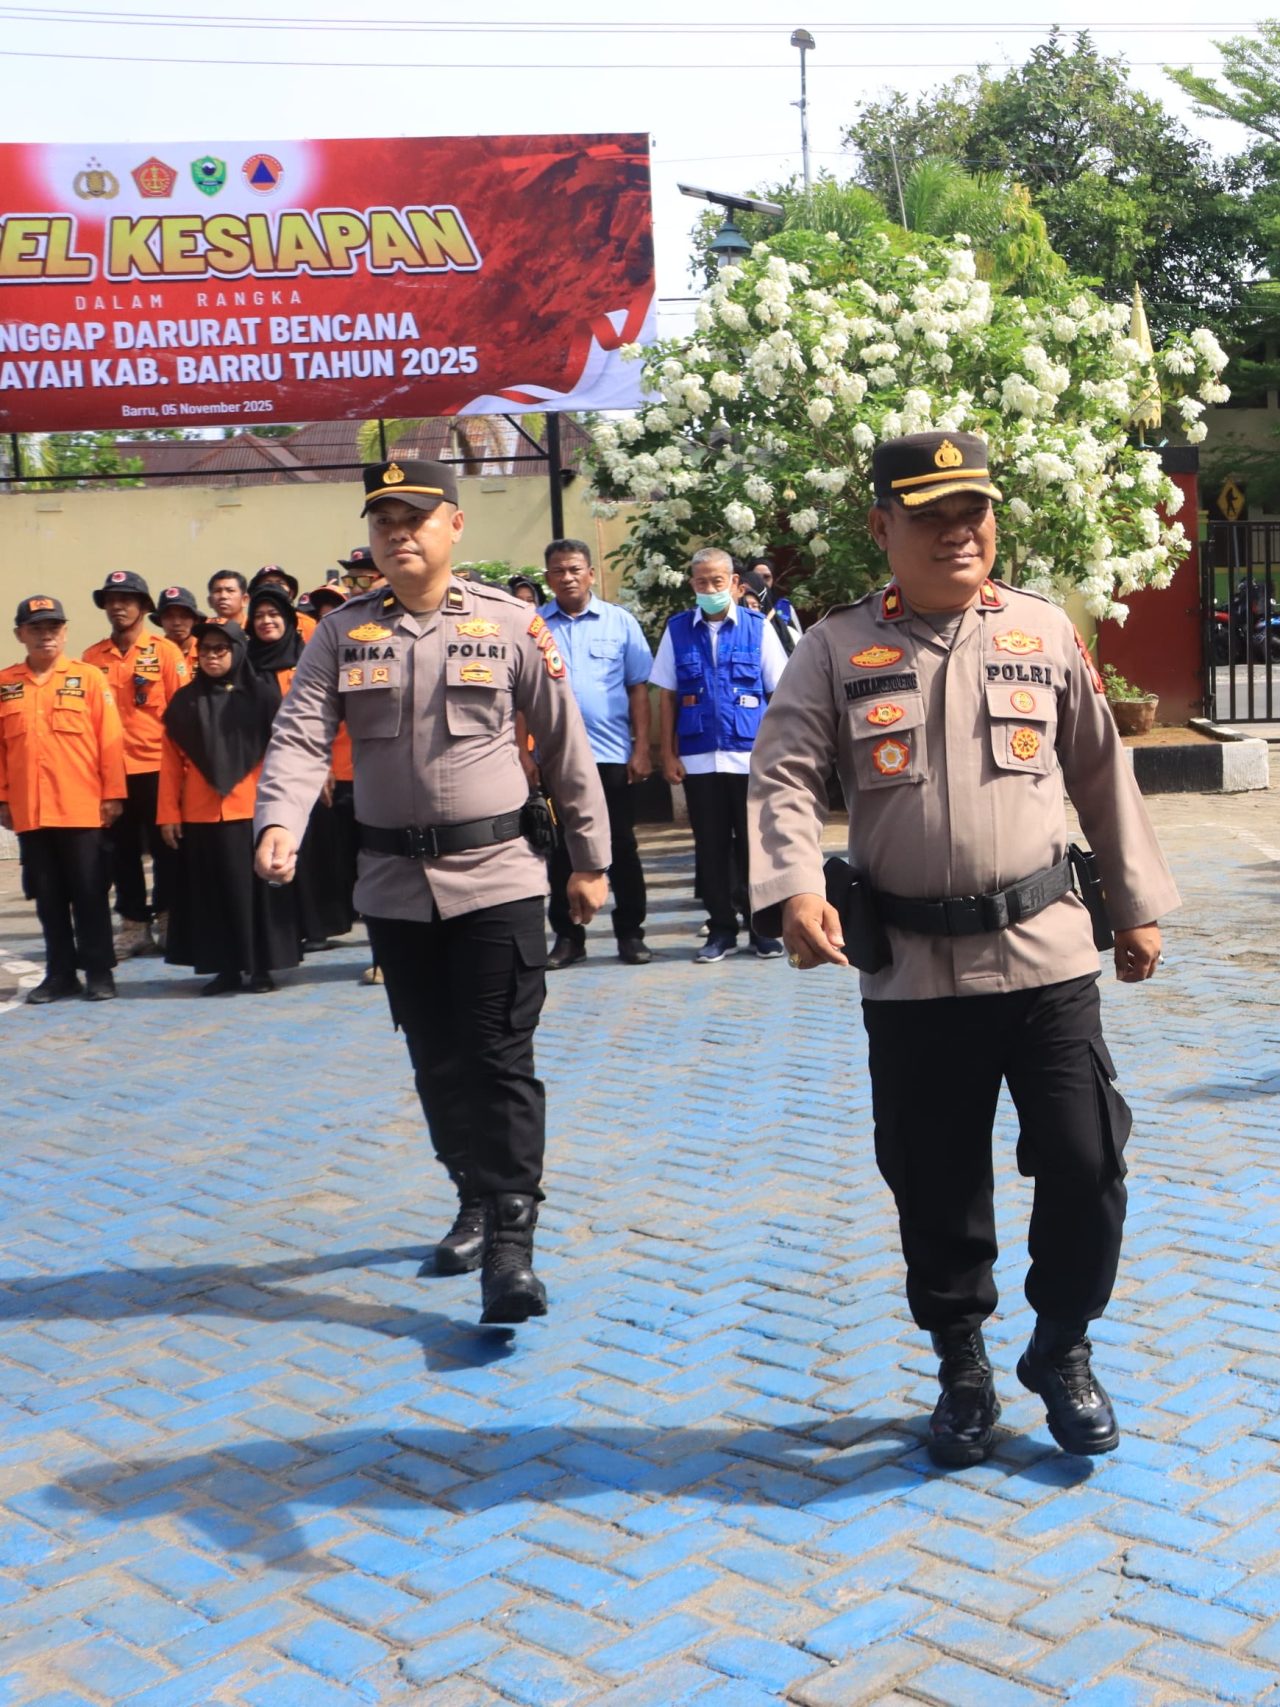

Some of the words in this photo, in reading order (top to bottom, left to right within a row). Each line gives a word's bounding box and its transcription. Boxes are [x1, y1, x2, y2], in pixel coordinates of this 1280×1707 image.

[0, 215, 94, 279] EL
[107, 207, 479, 278] KESIAPAN
[75, 294, 163, 311] DALAM
[197, 290, 302, 307] RANGKA
[113, 317, 261, 350] DARURAT
[269, 311, 421, 344] BENCANA
[91, 356, 169, 387] KAB.
[176, 353, 283, 384] BARRU
[289, 349, 394, 380] TAHUN
[402, 346, 478, 376] 2025
[122, 404, 159, 418] Barru,
[161, 404, 177, 416] 05
[180, 401, 241, 415] November
[243, 400, 273, 412] 2025
[344, 646, 396, 662] MIKA
[448, 643, 507, 660] POLRI
[985, 663, 1053, 685] POLRI
